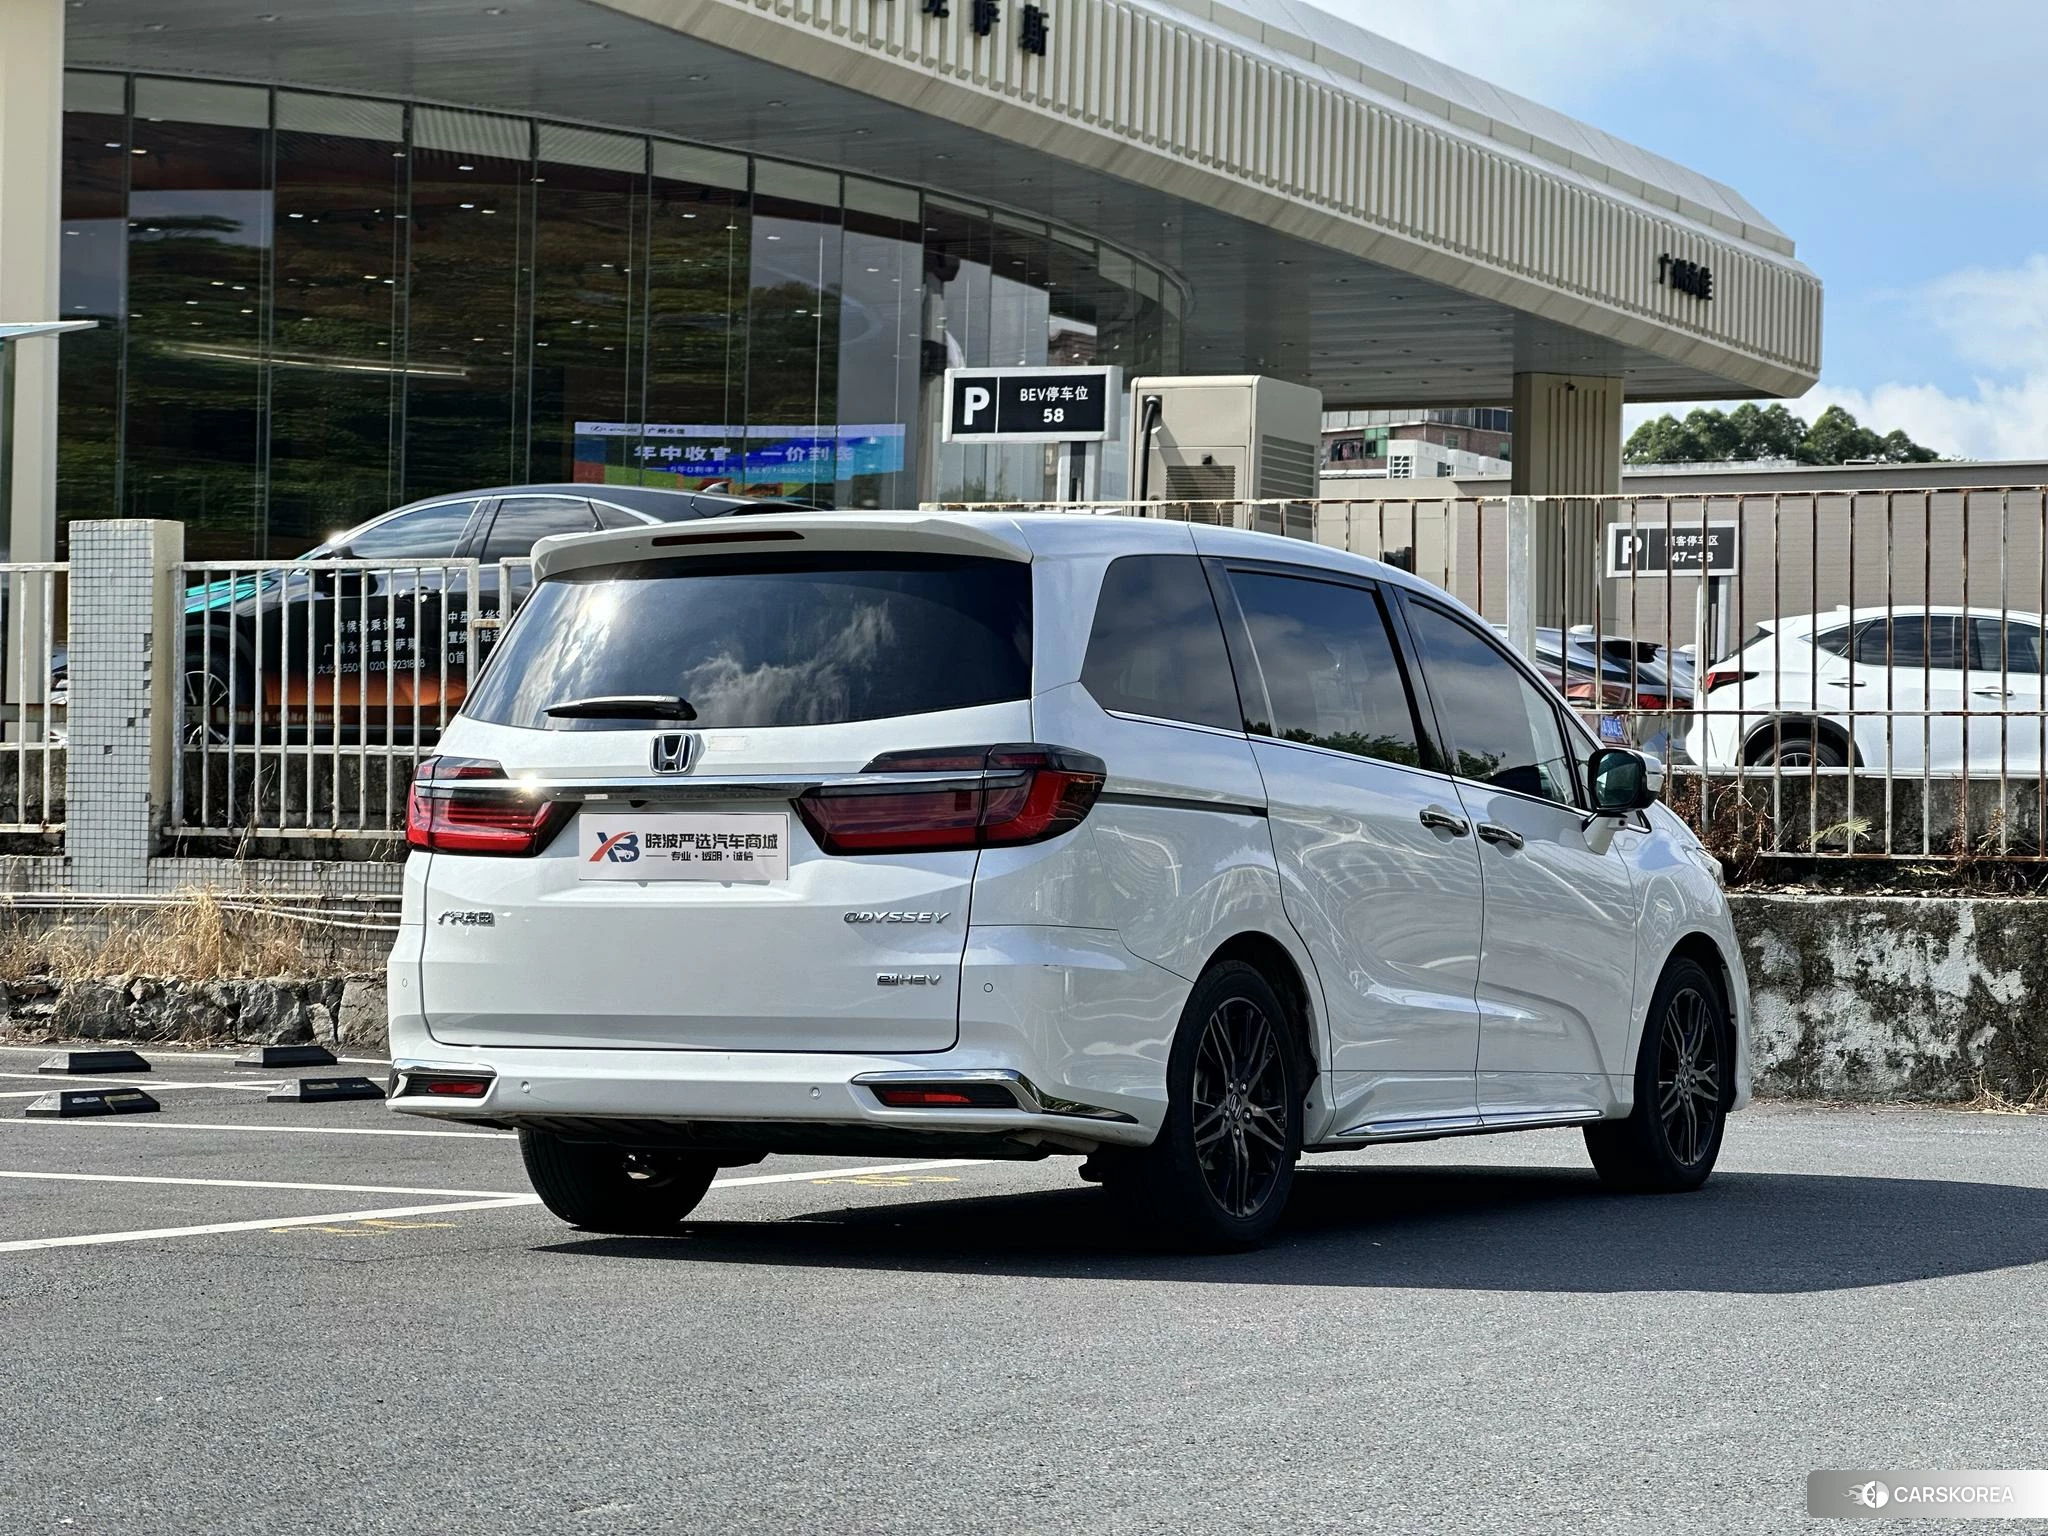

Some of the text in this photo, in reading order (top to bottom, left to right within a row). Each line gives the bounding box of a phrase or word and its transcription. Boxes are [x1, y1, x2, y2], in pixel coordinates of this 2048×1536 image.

[1020, 386, 1089, 402] BEV停车位
[963, 387, 990, 426] P
[1043, 408, 1065, 423] 58
[1622, 536, 1642, 564] P
[645, 833, 778, 850] 晓波严选汽车商城
[843, 911, 951, 924] ODYSSEY
